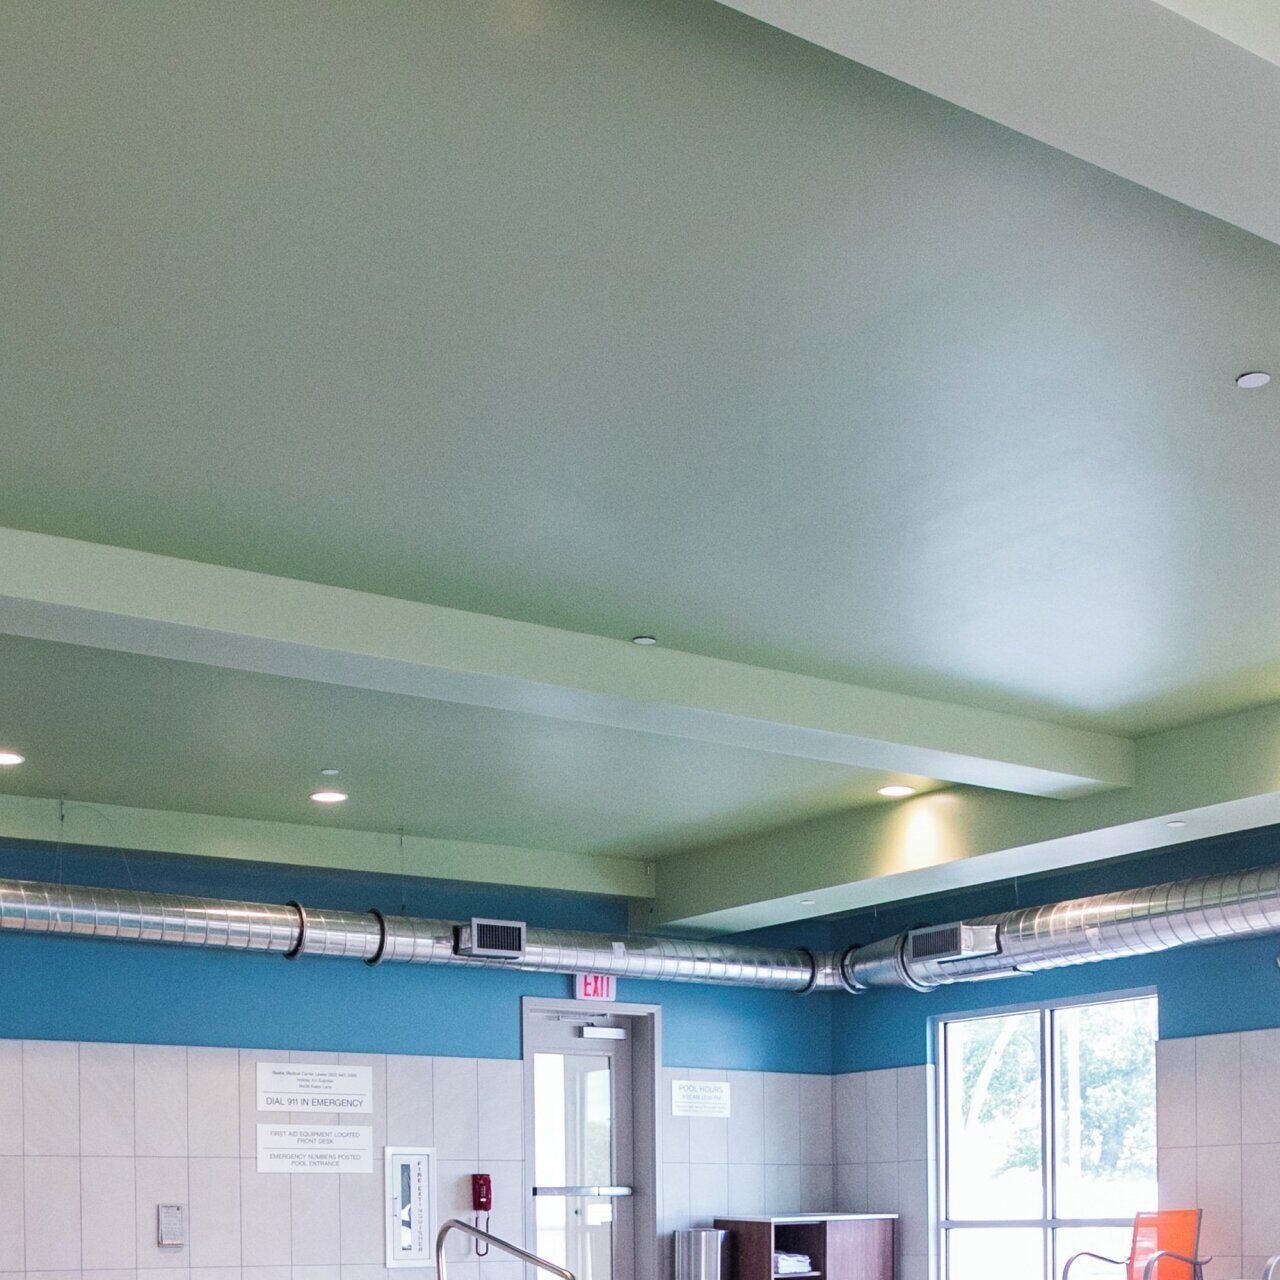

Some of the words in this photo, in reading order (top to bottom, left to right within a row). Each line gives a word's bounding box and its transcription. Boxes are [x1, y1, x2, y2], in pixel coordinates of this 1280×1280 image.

[583, 974, 610, 998] EXIT
[265, 1096, 286, 1106] DIAL
[287, 1097, 299, 1106] 911
[300, 1097, 310, 1107] IN
[311, 1098, 364, 1108] EMERGENCY
